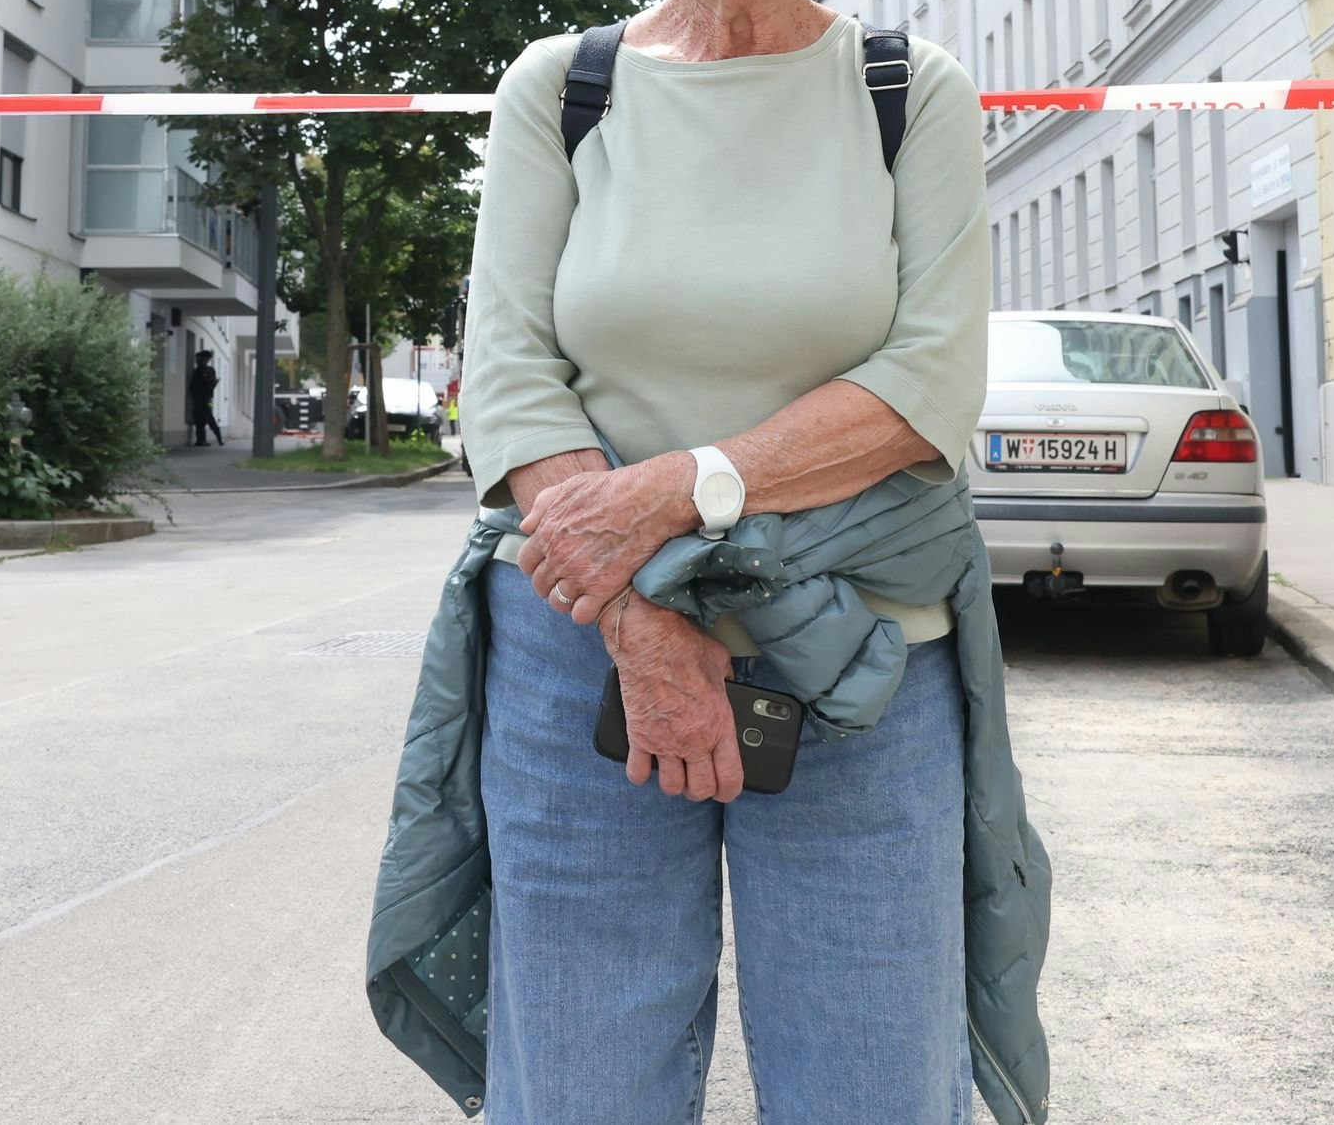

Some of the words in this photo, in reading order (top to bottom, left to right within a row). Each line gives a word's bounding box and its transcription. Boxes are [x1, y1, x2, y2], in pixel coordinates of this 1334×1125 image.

[1007, 439, 1021, 459] W
[1037, 439, 1099, 460] 15924
[1105, 440, 1116, 460] H
